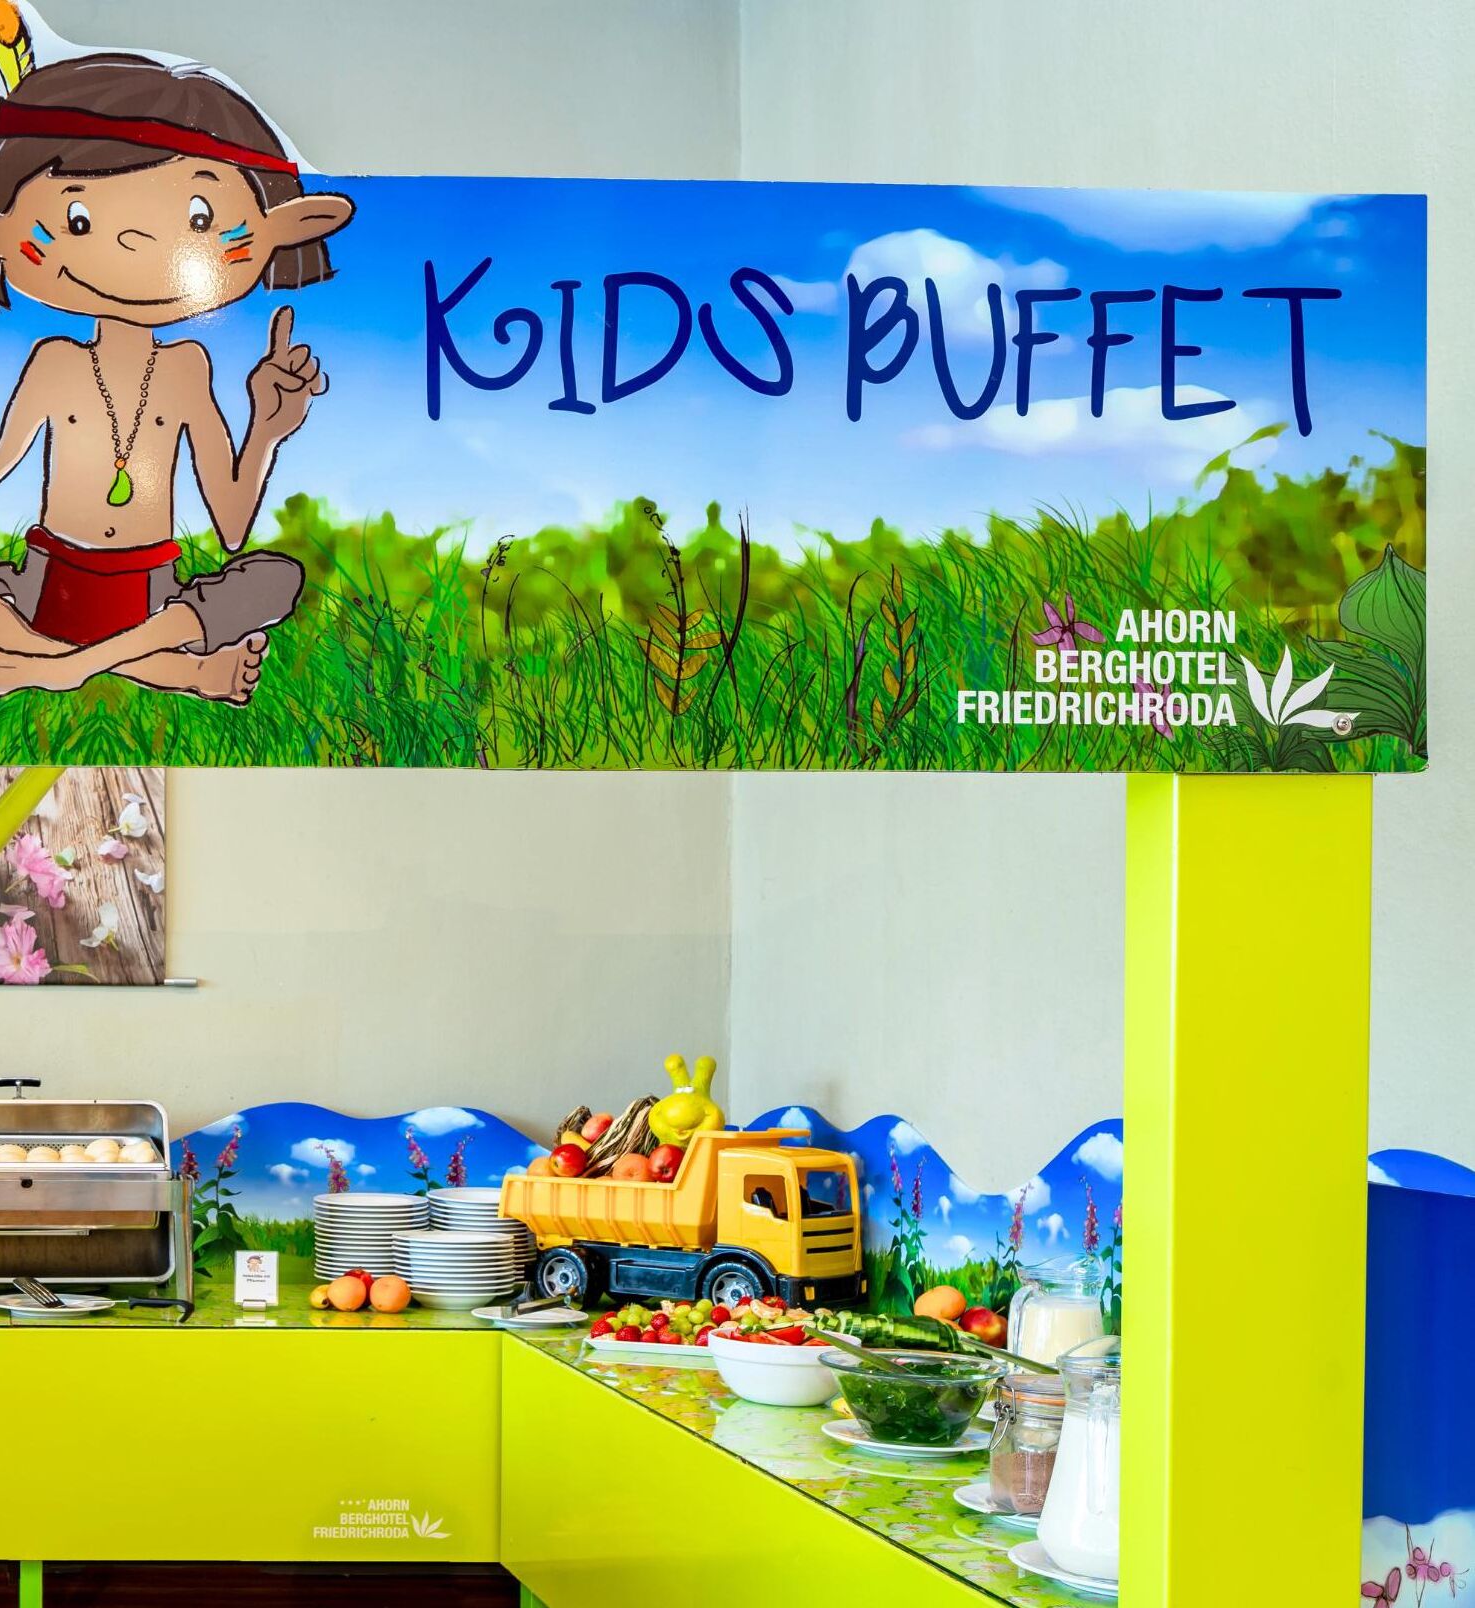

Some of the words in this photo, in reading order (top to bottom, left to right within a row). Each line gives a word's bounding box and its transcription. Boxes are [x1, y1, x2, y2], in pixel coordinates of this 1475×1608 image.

[423, 256, 795, 422] KIDS
[846, 271, 1343, 438] BUFFET
[1116, 609, 1237, 644] AHORN
[1035, 650, 1238, 685] BERGHOTEL
[956, 690, 1238, 727] FRIEDRICHRODA
[339, 1513, 410, 1525] BERGHOTEL
[367, 1499, 410, 1511] AHORN
[313, 1526, 410, 1539] FRIEDRICHRODA
